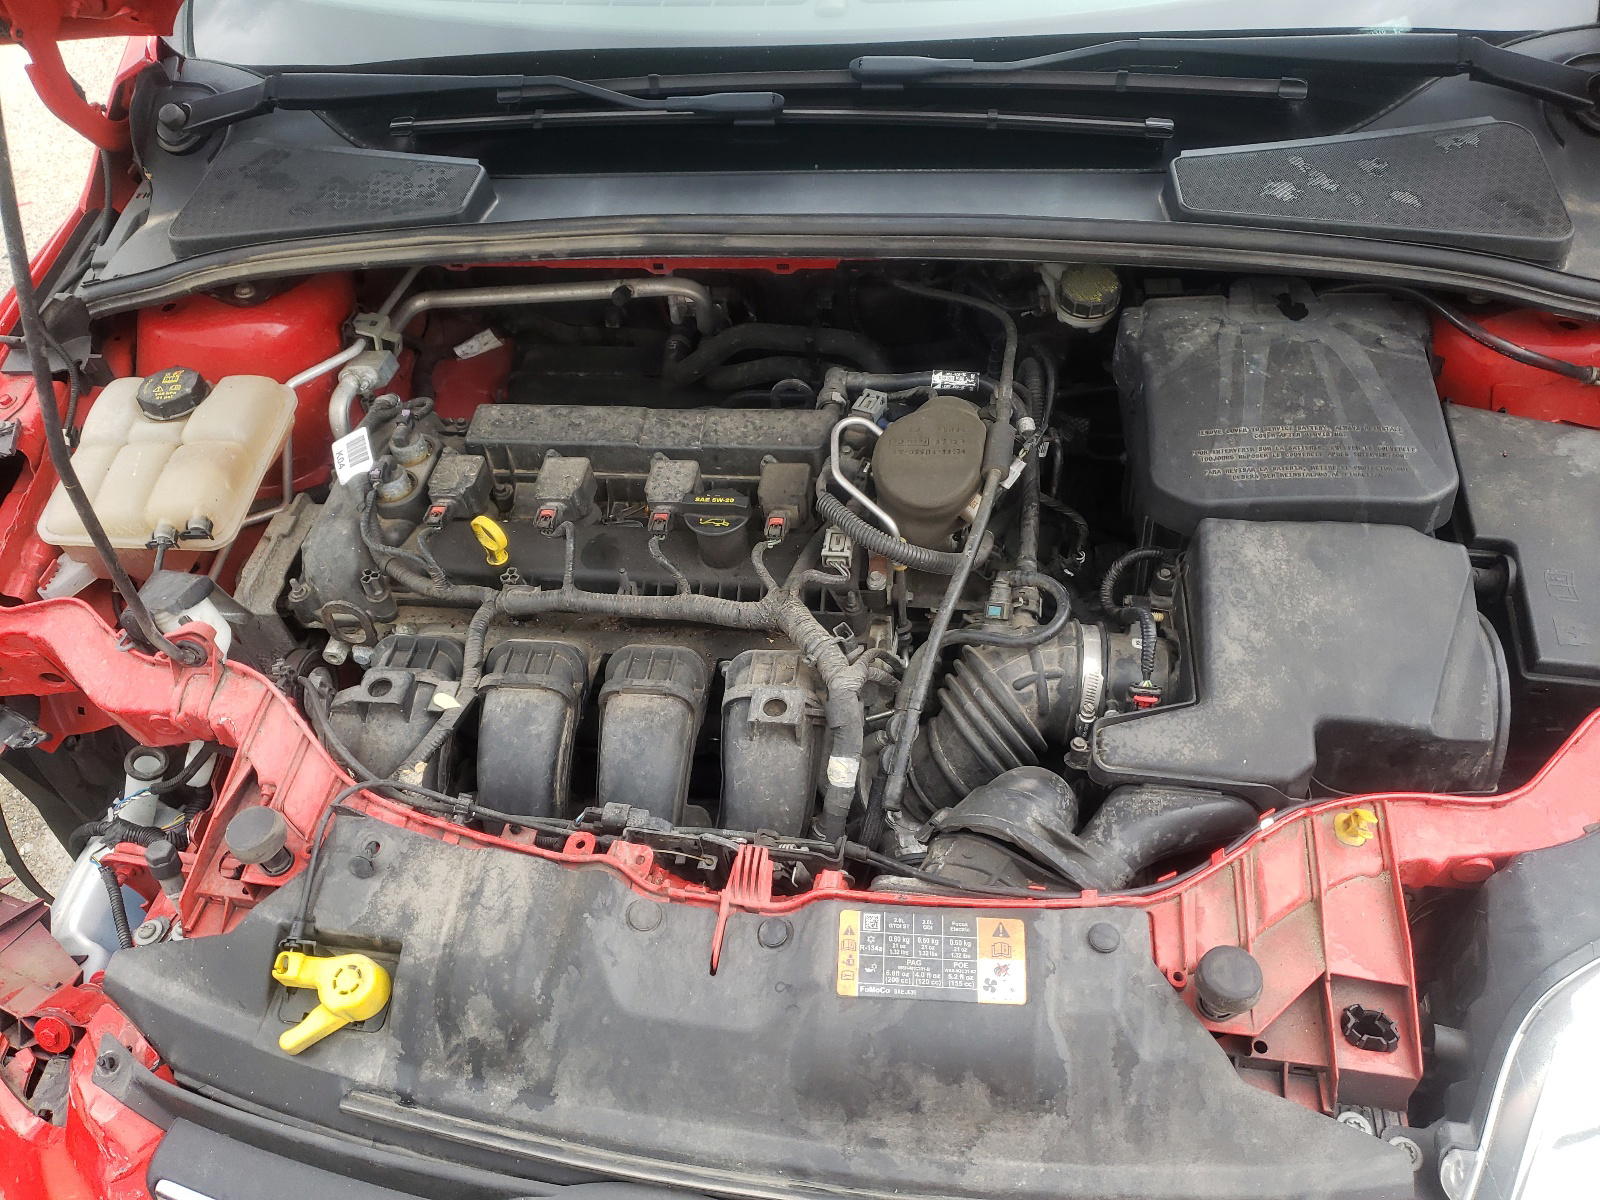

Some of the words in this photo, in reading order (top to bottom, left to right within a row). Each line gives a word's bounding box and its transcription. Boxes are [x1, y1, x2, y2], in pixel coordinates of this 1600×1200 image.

[902, 936, 910, 945] kg
[963, 939, 972, 948] kg
[859, 944, 883, 952] R-134a
[859, 985, 891, 995] FoMoCo
